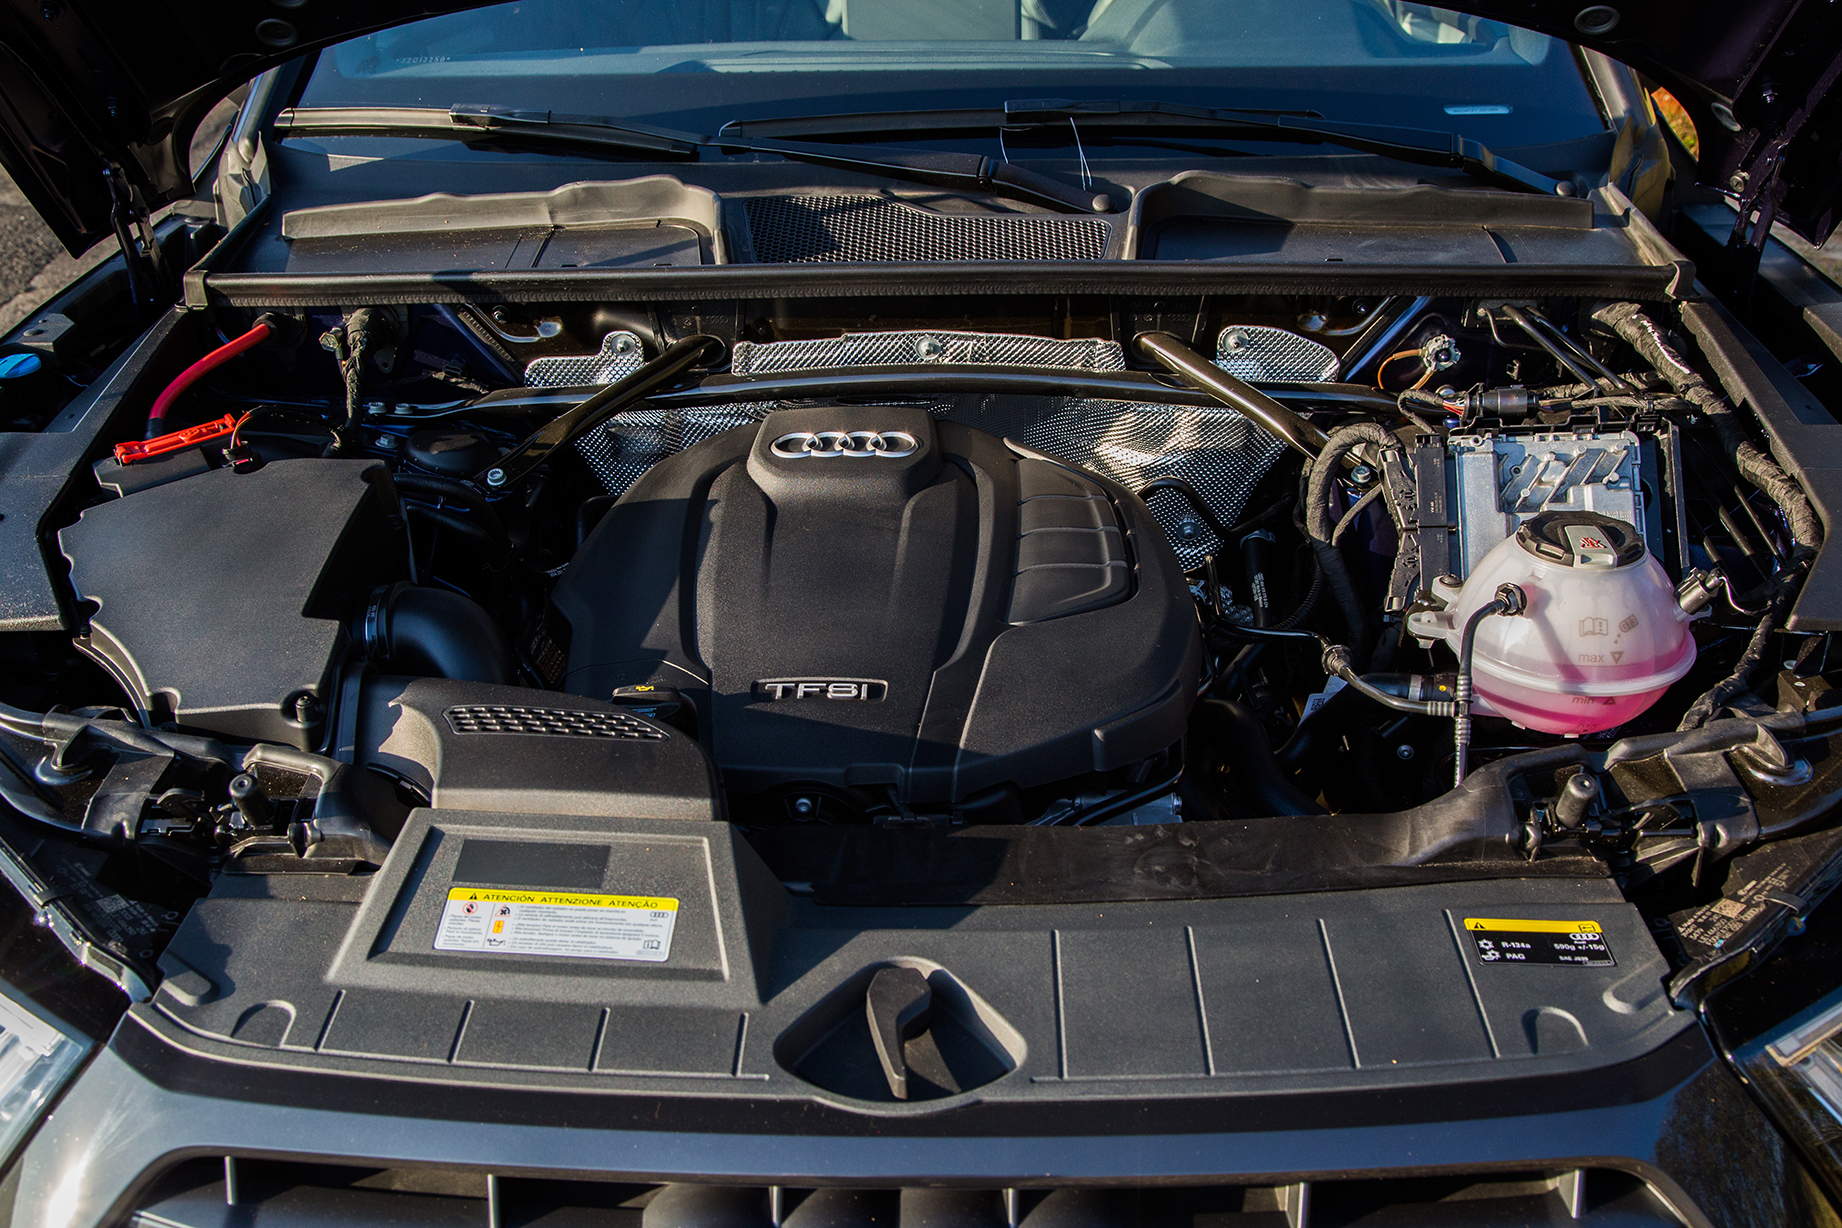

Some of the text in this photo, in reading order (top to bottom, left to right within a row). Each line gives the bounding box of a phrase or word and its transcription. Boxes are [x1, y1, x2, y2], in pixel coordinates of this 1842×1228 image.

[1578, 654, 1605, 663] max
[765, 682, 868, 700] TFSI
[1571, 696, 1595, 704] min
[483, 893, 658, 909] ATENCIÓN ATTENZIONE ATENÇÃO
[1501, 941, 1532, 949] R-134a
[1505, 952, 1526, 960] PAG
